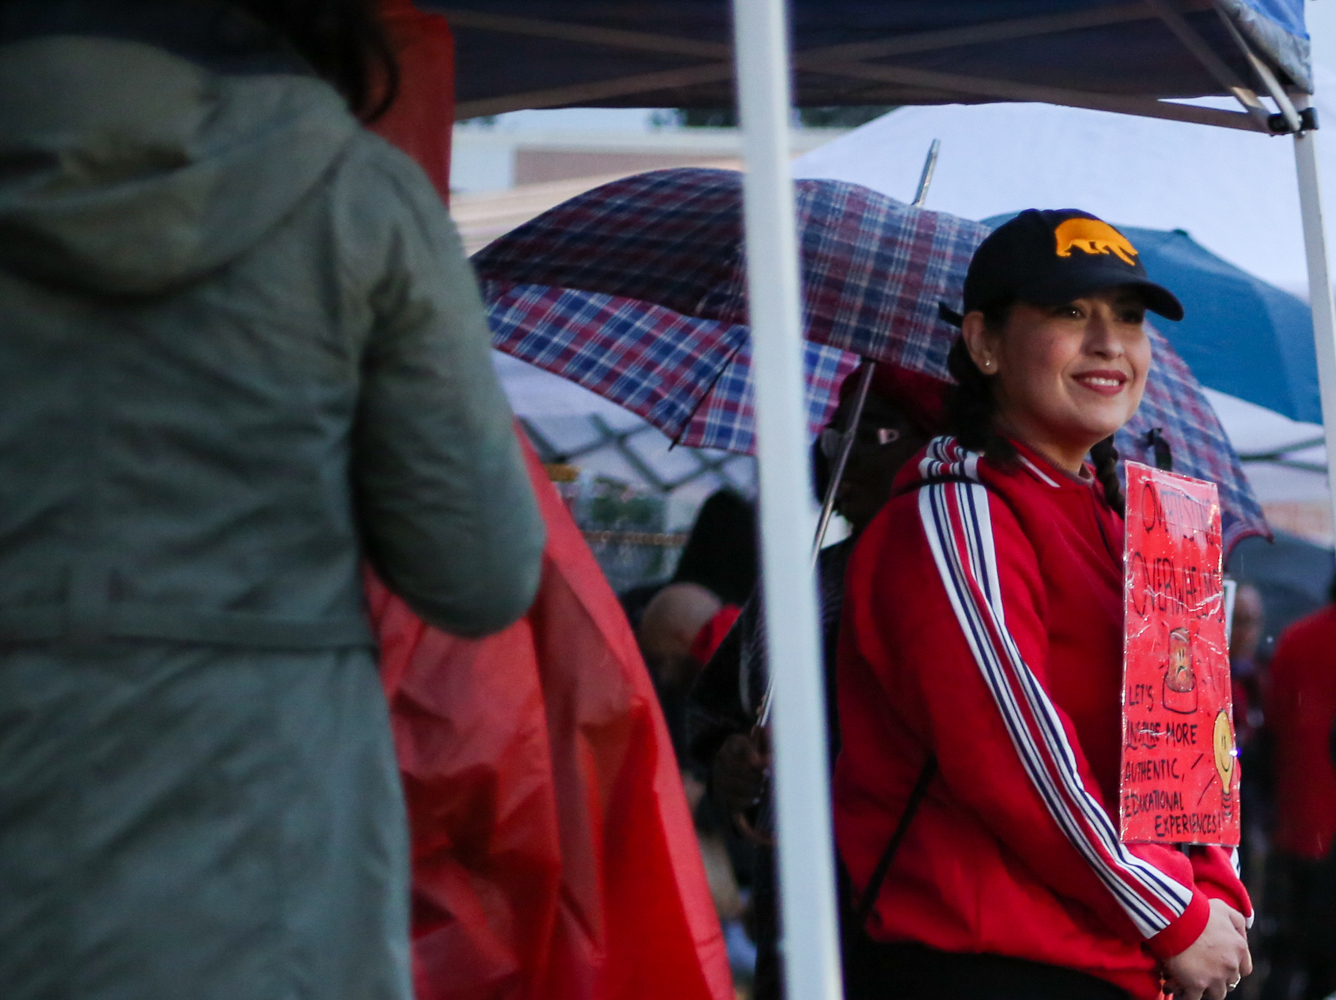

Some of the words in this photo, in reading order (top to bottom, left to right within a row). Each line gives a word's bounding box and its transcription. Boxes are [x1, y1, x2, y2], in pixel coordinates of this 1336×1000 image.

[1129, 684, 1154, 712] LET'S
[1166, 722, 1198, 747] MORE
[1125, 757, 1185, 785] AUTHENTIC,
[1124, 789, 1184, 817] EDUCATIONAL
